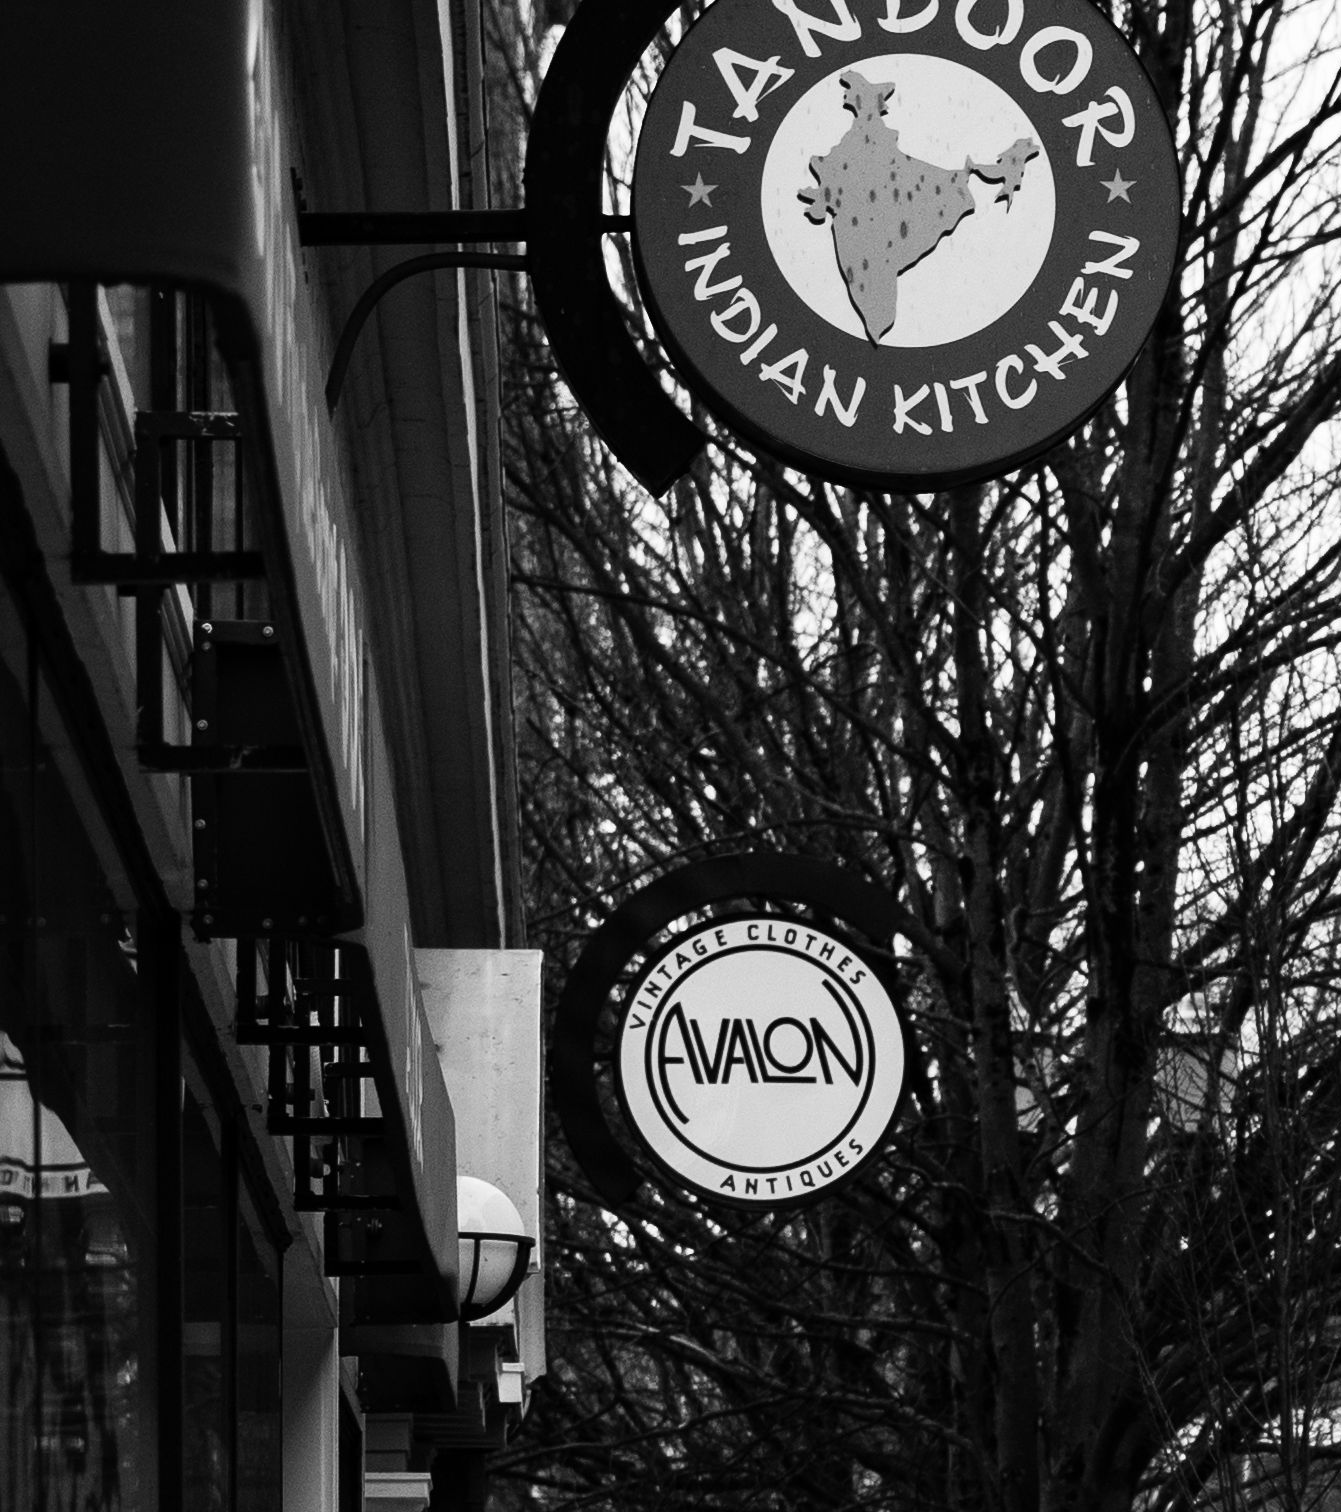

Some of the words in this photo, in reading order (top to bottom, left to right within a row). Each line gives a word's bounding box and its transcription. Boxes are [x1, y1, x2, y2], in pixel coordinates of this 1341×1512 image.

[677, 224, 867, 427] INDIAN
[892, 230, 1141, 435] KITCHEN
[629, 930, 728, 1030] VINTAGE
[746, 924, 867, 986] CLOTHES
[658, 979, 864, 1125] AVALON
[720, 1138, 865, 1195] ANTIQUES
